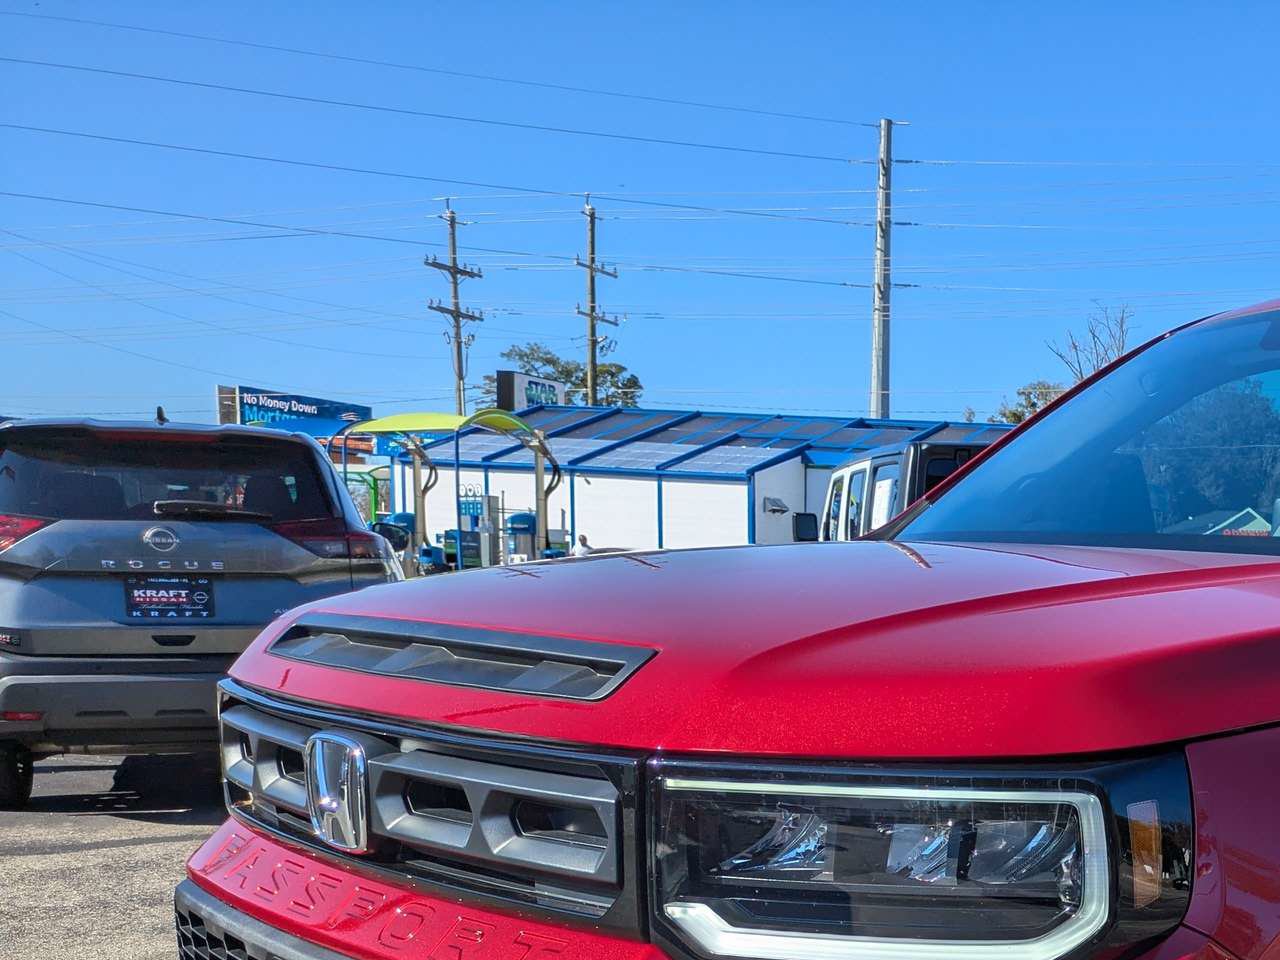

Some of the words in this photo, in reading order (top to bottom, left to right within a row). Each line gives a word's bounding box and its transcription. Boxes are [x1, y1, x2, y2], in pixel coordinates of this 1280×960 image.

[243, 393, 257, 405] No
[259, 394, 290, 412] Money
[291, 400, 318, 414] Down
[101, 559, 225, 570] ROGUE
[133, 589, 190, 598] KRAFT
[132, 610, 209, 618] KRAFT
